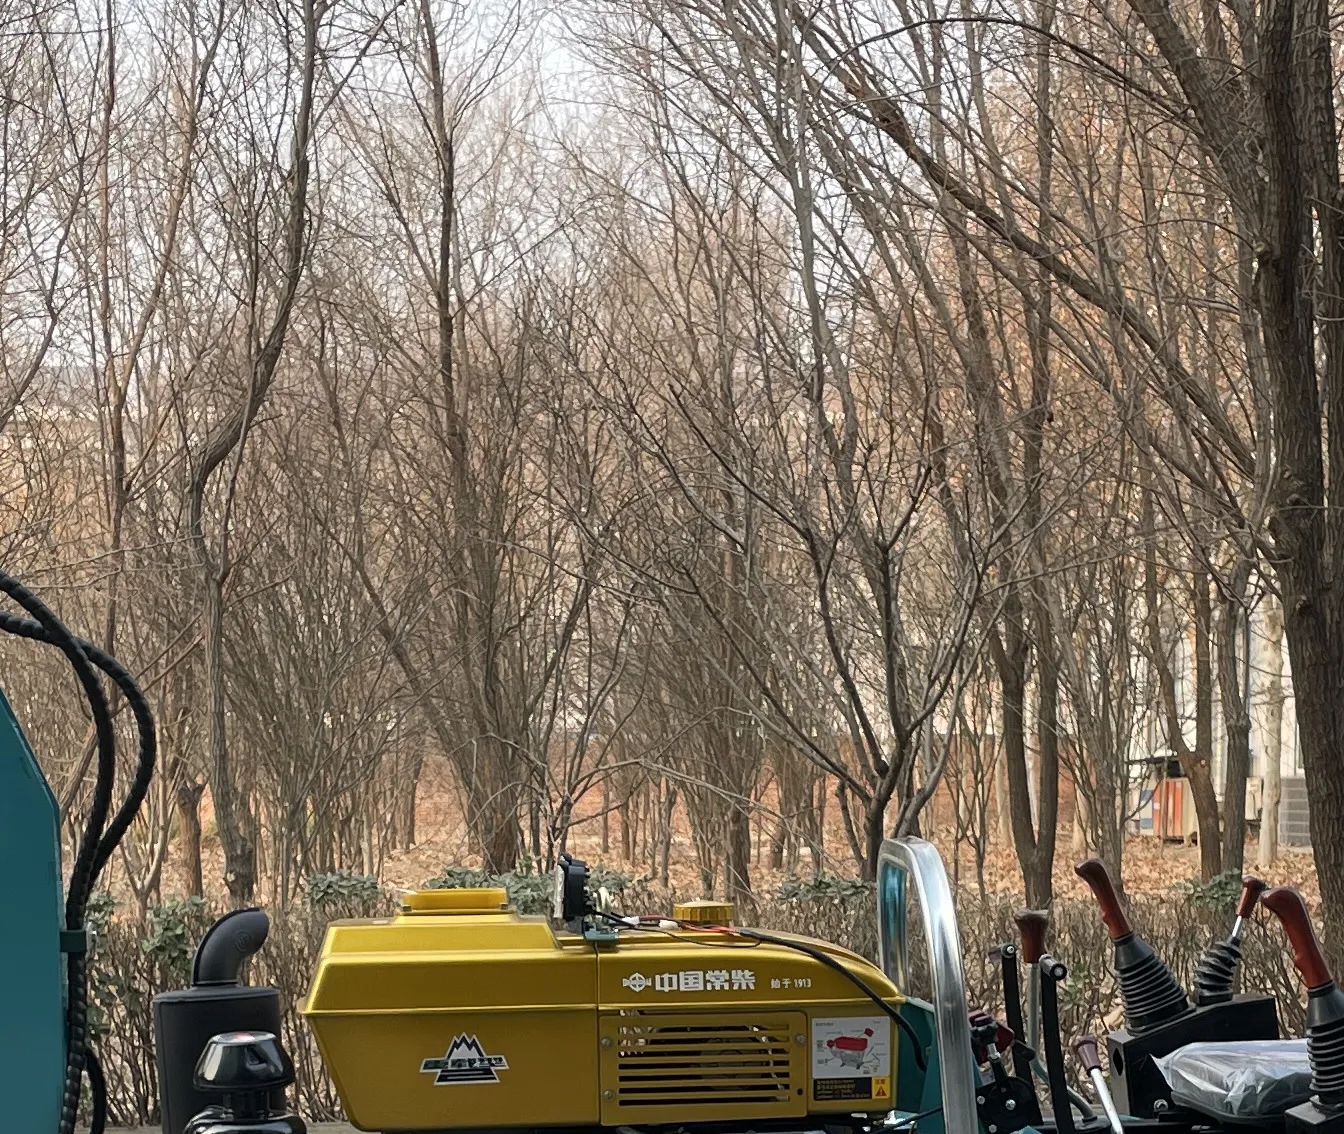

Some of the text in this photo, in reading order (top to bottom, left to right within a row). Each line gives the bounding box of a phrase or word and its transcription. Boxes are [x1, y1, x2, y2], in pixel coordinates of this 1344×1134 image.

[655, 969, 756, 993] 中国常柴
[793, 978, 812, 988] 1913
